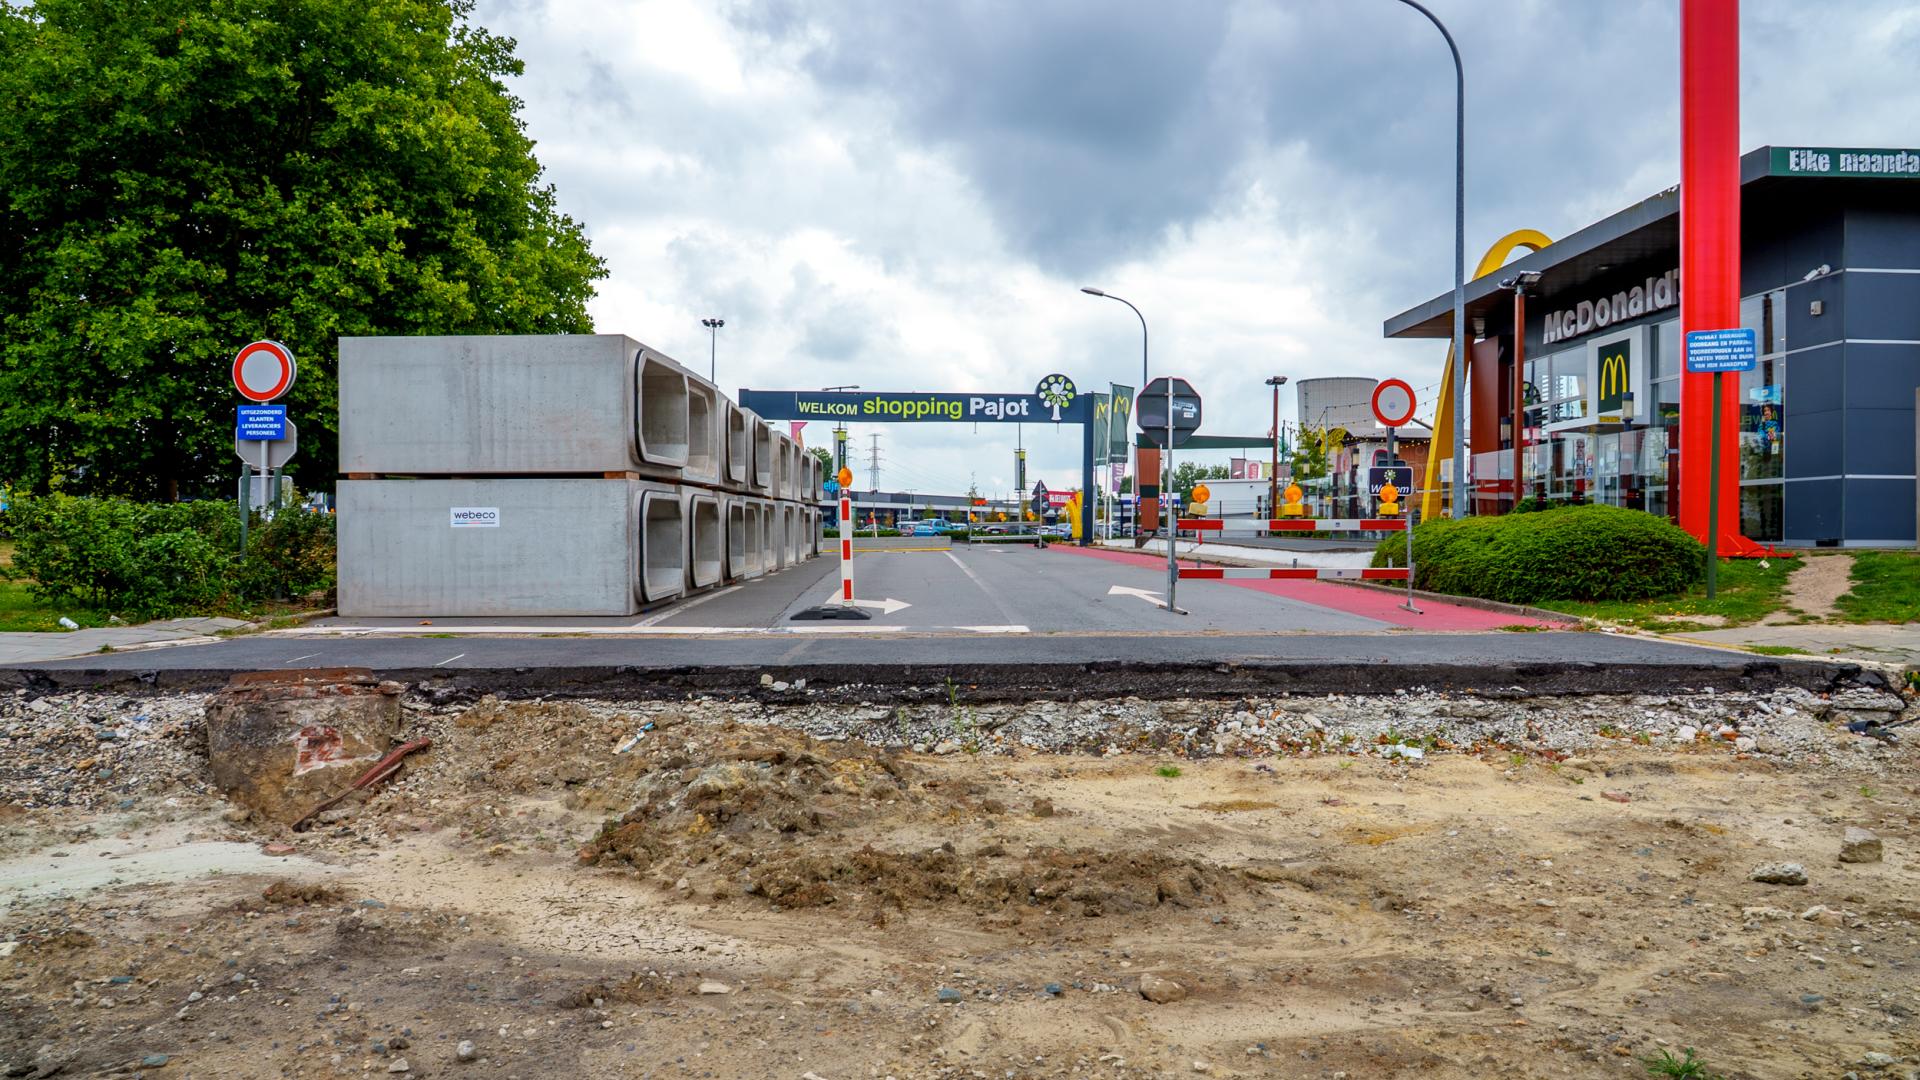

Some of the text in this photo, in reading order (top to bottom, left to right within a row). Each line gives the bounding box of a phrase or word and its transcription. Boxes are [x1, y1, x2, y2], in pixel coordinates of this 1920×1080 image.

[1789, 149, 1830, 172] Elke
[1543, 268, 1681, 344] McDonald'
[798, 397, 1029, 420] WELKOM shopping Pajot
[454, 510, 496, 519] webeco
